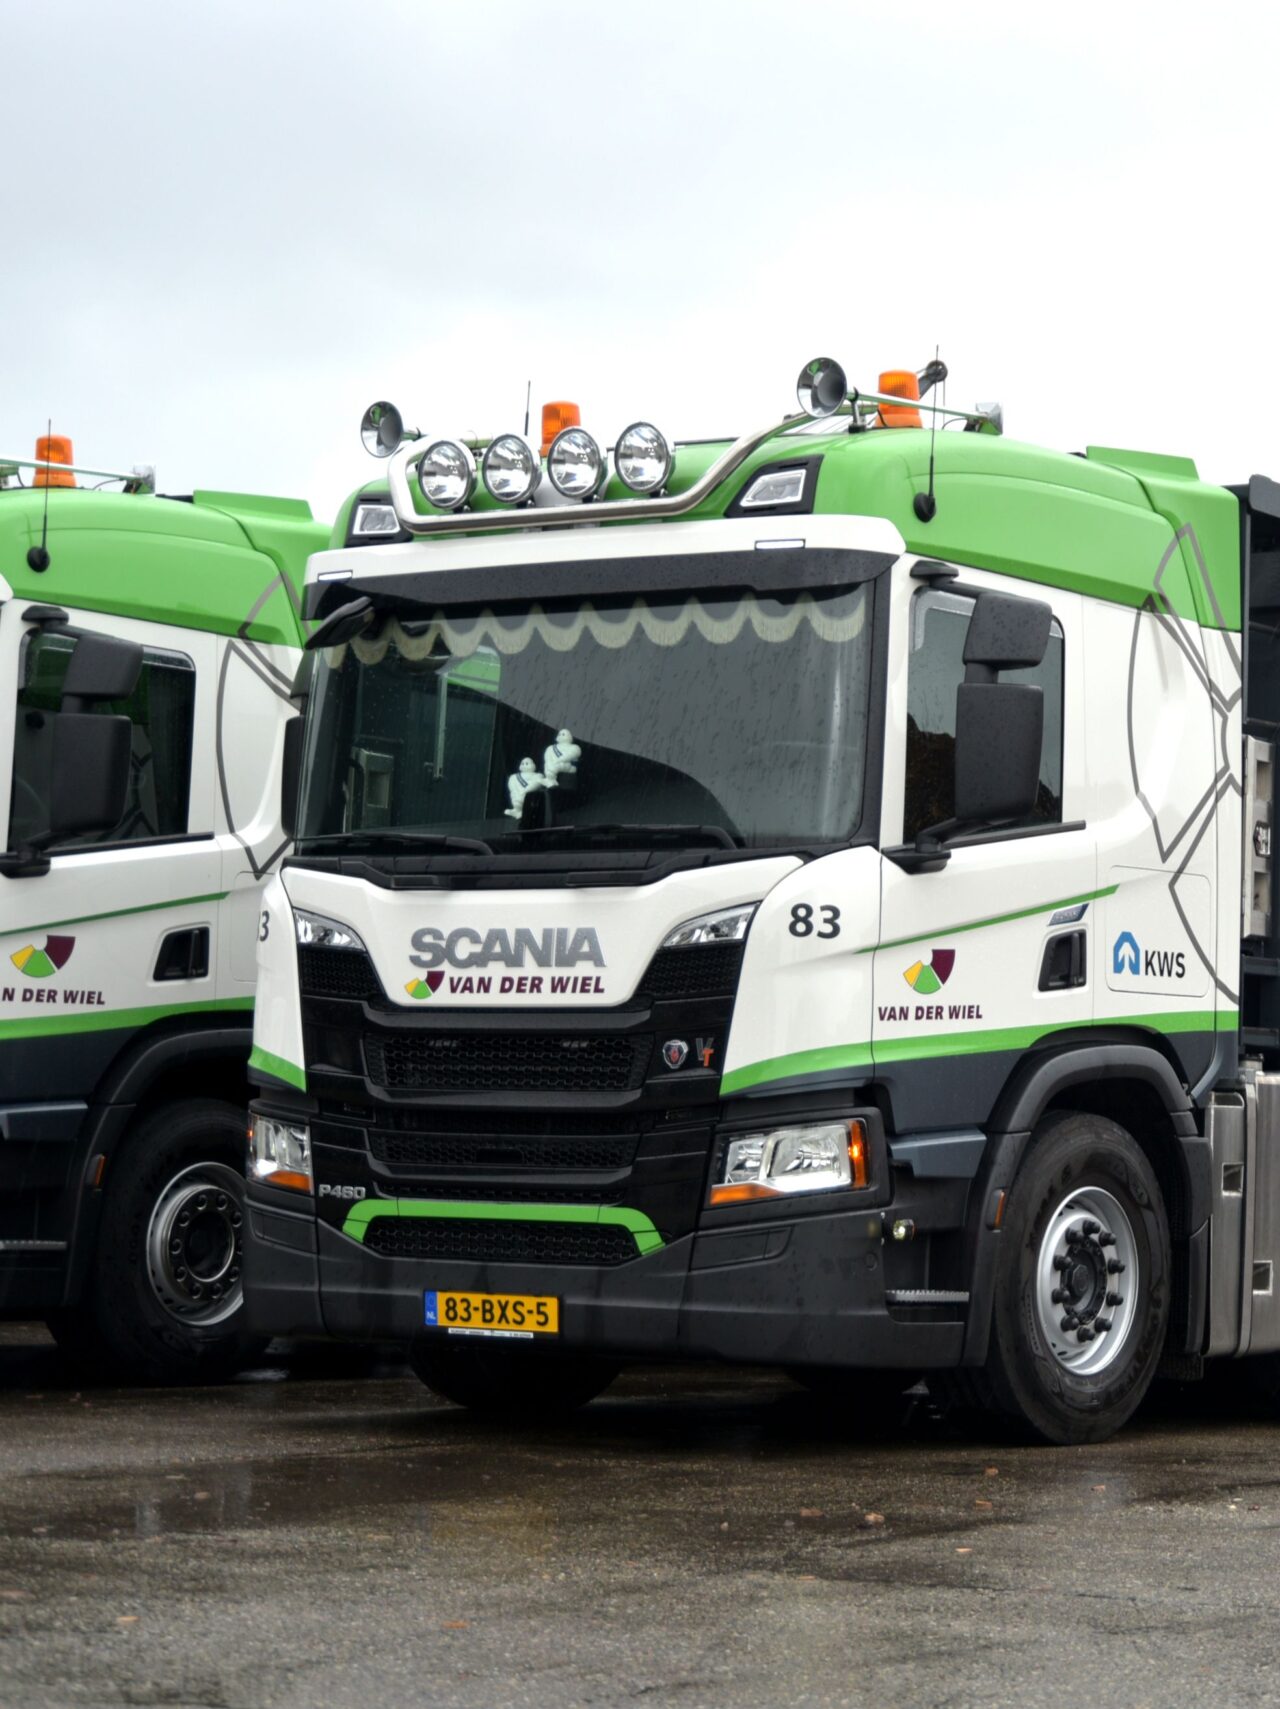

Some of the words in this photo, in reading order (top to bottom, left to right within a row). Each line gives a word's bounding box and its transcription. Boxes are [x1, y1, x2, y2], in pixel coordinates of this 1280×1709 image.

[788, 902, 841, 939] 83
[409, 927, 607, 969] SCANIA
[1144, 949, 1186, 979] KWS
[449, 976, 492, 994] VAN
[500, 976, 543, 994] DER
[551, 976, 605, 994] WIEL
[22, 988, 58, 1003] DER
[64, 990, 105, 1005] WIEL
[878, 1006, 909, 1021] VAN
[915, 1005, 944, 1020] DER
[948, 1004, 983, 1019] WIEL
[318, 1183, 367, 1200] P460
[426, 1311, 436, 1320] NL
[444, 1296, 550, 1327] 83-BXS-5
